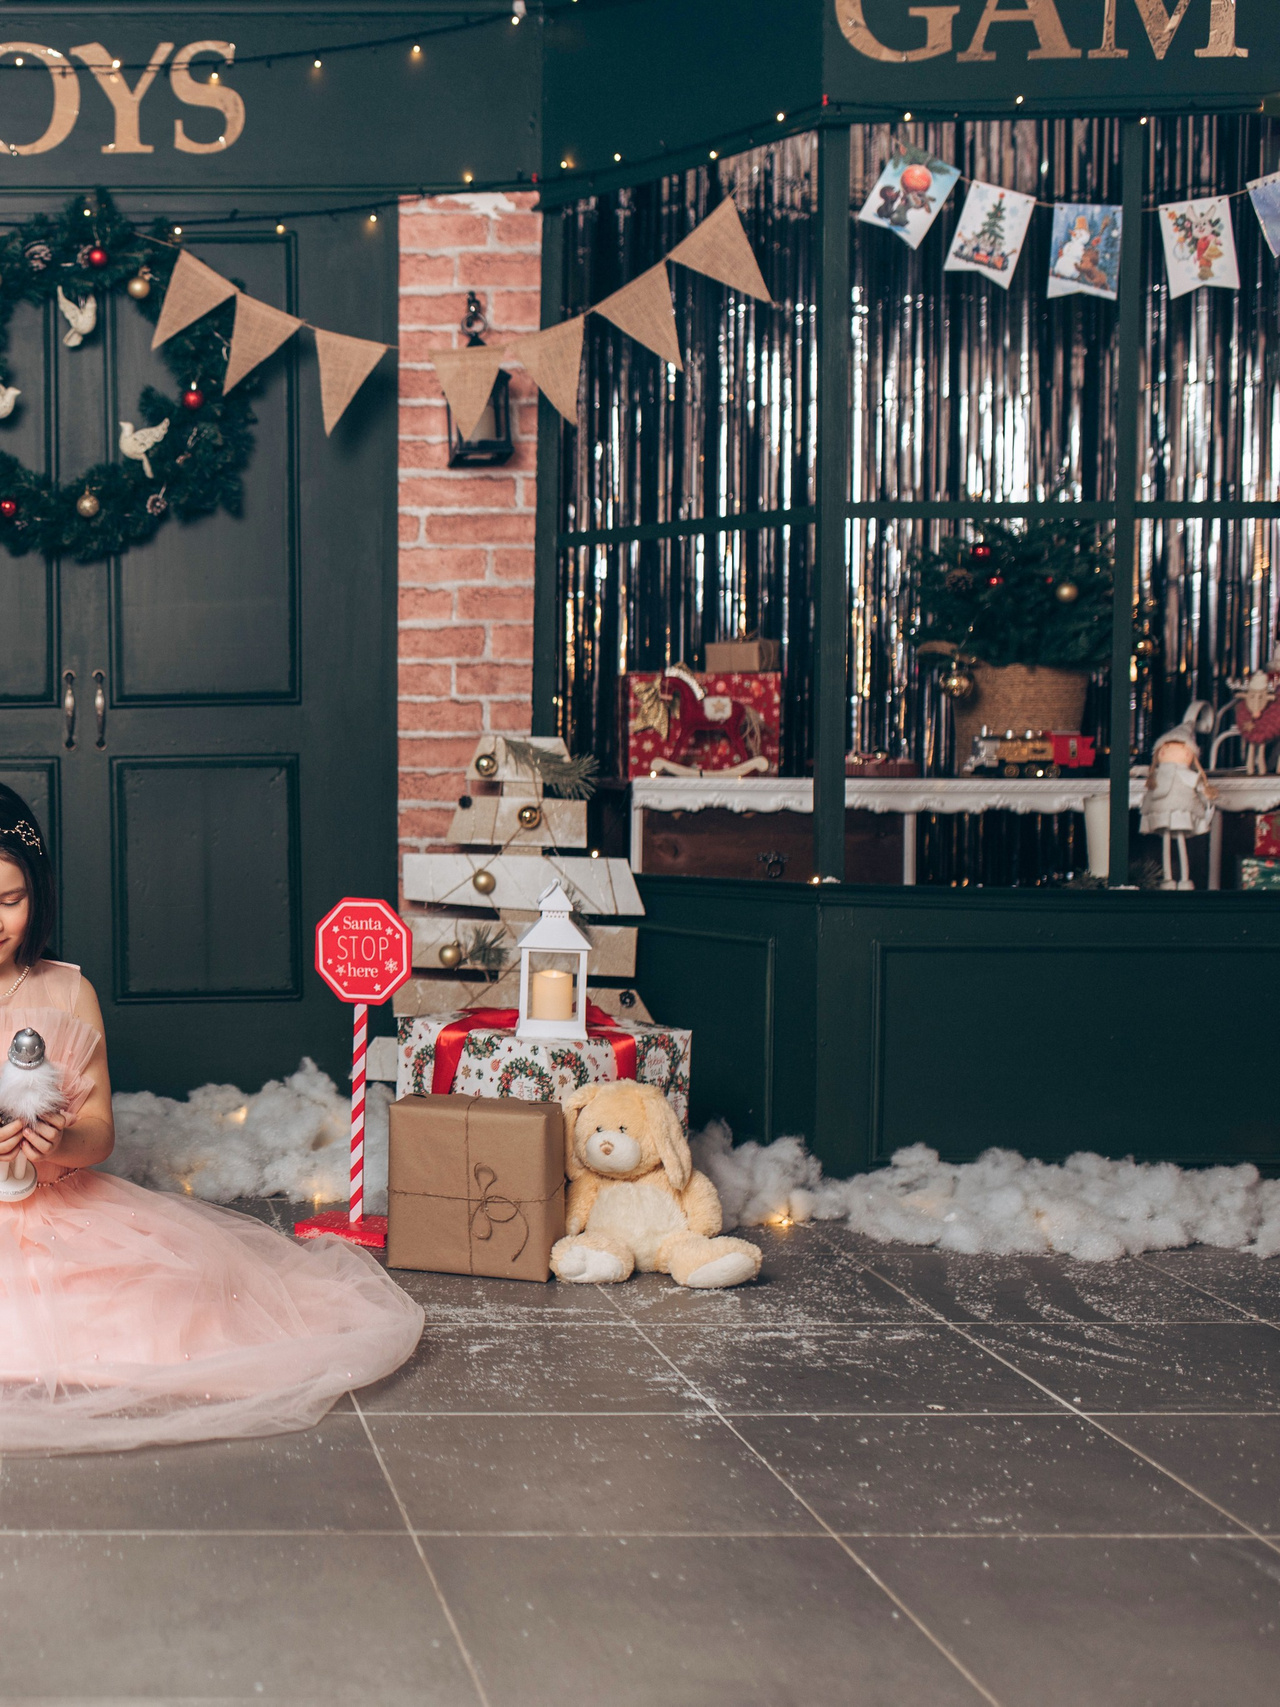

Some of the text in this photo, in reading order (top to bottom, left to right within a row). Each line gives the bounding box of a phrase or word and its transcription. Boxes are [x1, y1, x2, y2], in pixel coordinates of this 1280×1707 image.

[342, 915, 382, 931] Santa
[337, 935, 389, 961] STOP
[347, 962, 379, 978] here
